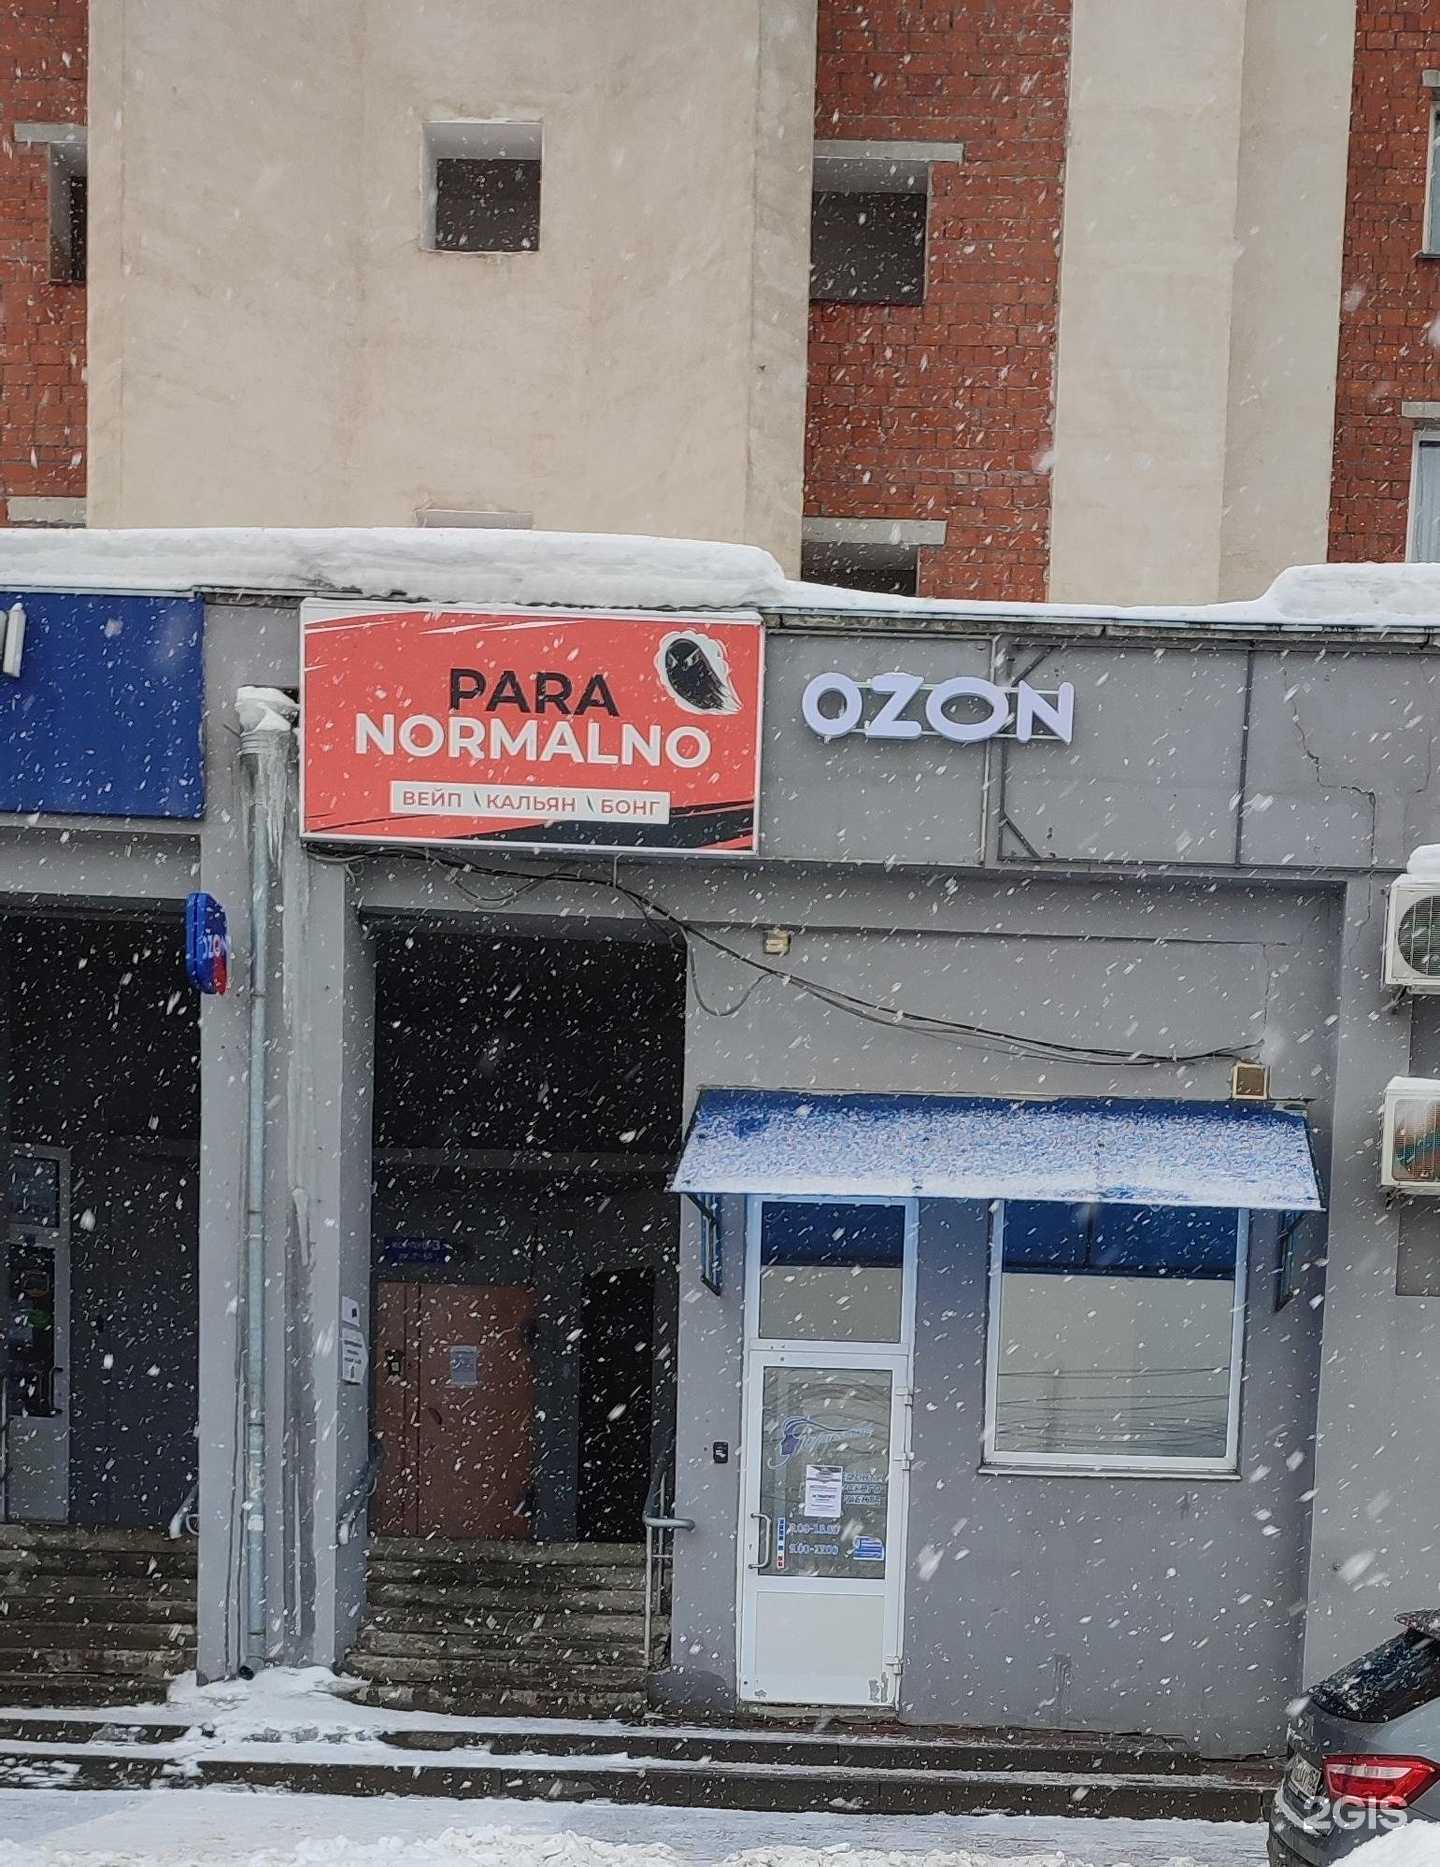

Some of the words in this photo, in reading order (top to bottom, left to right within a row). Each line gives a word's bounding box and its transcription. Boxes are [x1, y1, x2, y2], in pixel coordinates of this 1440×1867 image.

[449, 667, 620, 717] PARA
[801, 671, 1075, 745] OZON
[355, 712, 712, 769] NORMALNO
[402, 788, 463, 808] ВЕЙП
[486, 793, 576, 813] КАЛЬЯН
[601, 798, 661, 816] БОНГ
